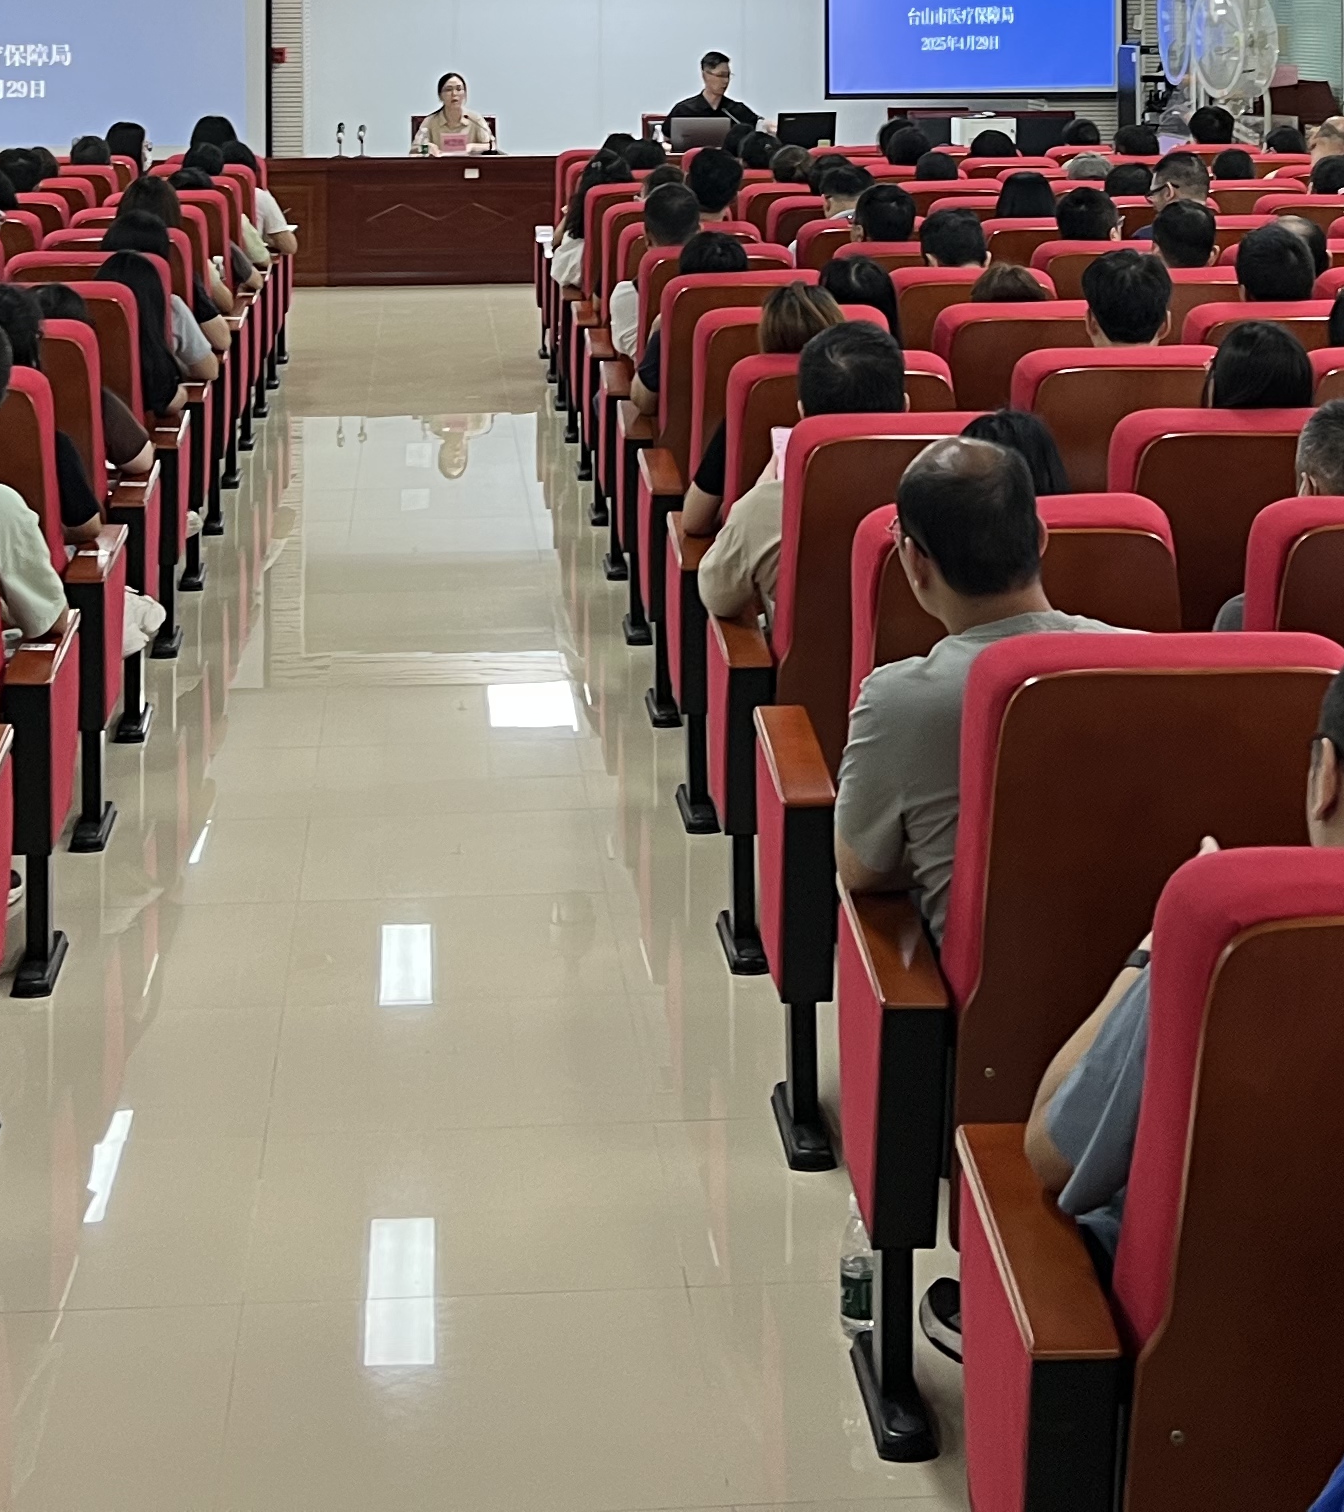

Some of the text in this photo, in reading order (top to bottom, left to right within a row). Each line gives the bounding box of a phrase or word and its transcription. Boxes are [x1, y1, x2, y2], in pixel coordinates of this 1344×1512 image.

[907, 6, 1015, 26] 台山市医疗保障局
[920, 36, 999, 51] 2025年4月29日
